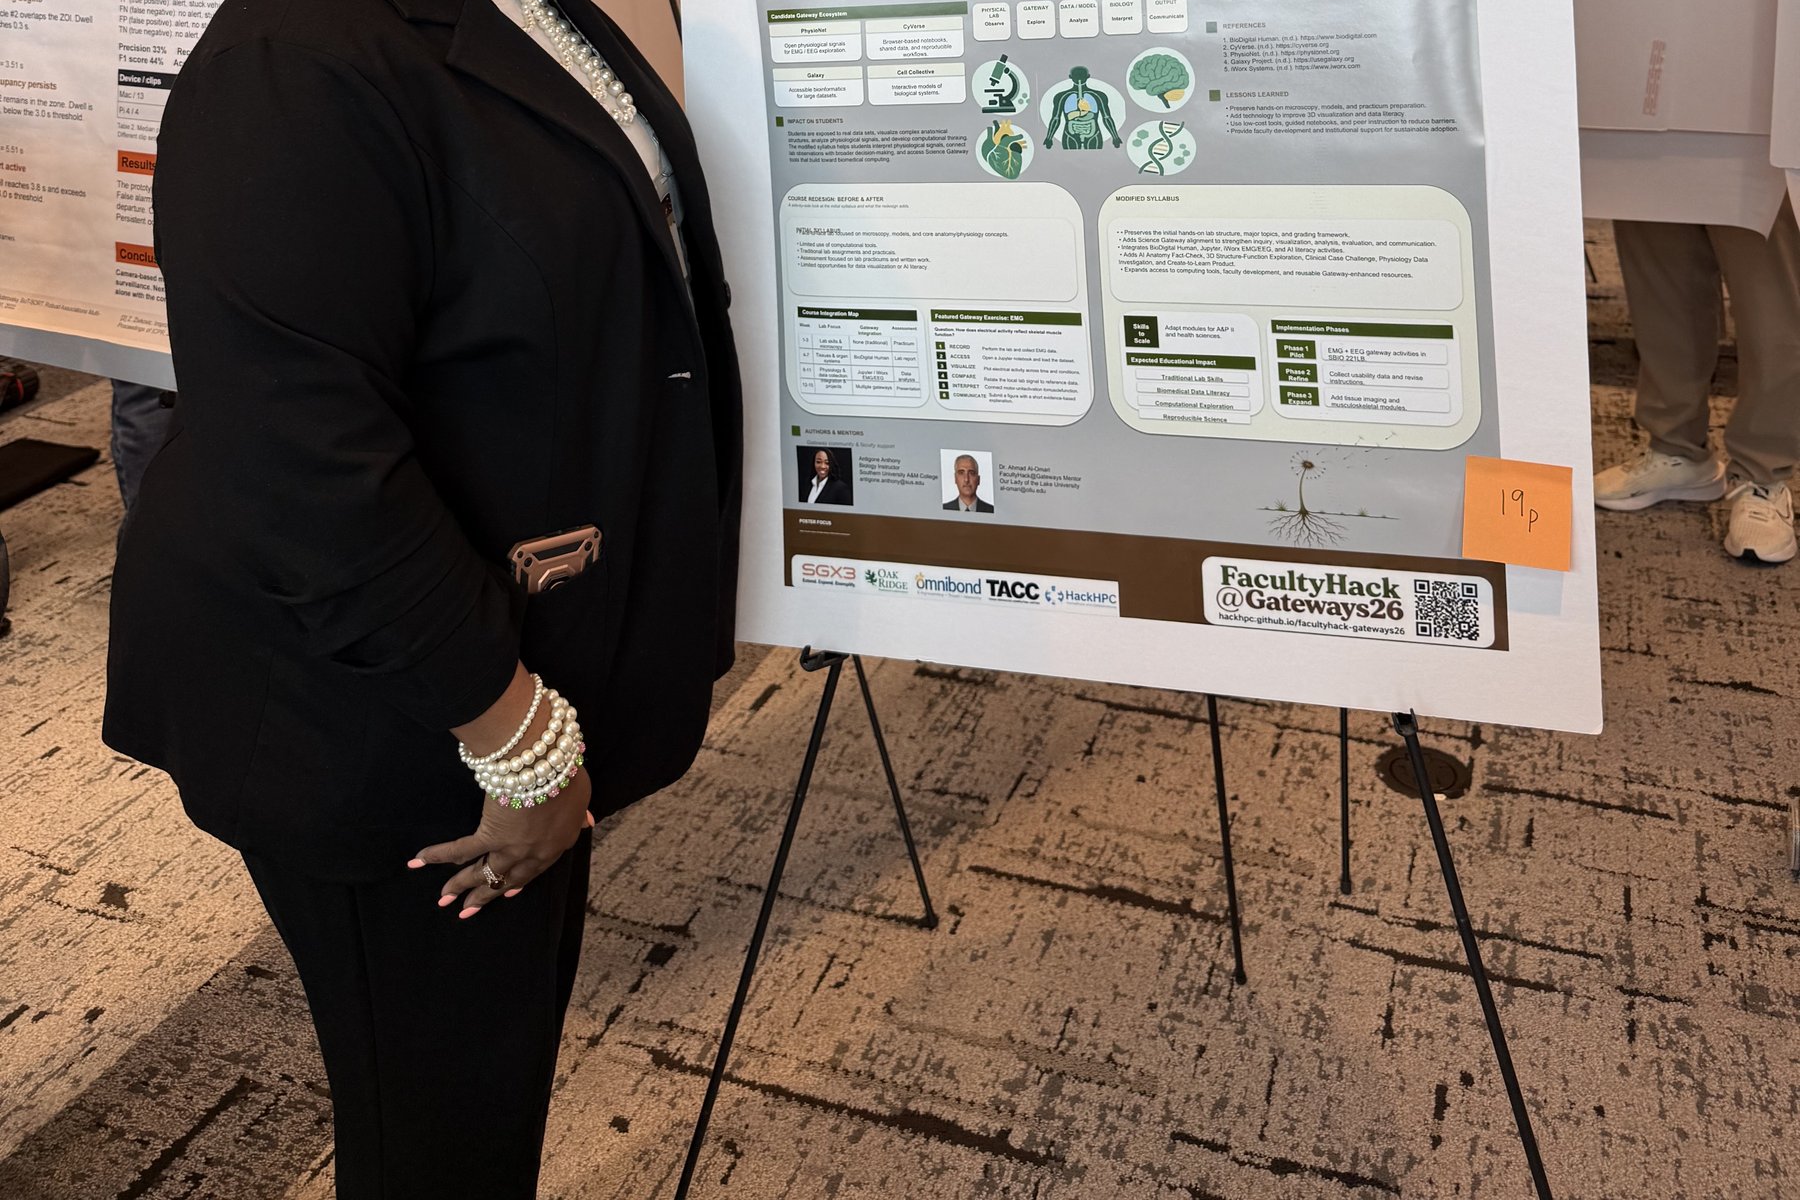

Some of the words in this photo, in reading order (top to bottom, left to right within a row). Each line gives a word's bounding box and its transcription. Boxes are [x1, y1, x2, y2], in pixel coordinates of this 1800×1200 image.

[118, 43, 150, 51] Precision
[122, 156, 156, 171] Results
[802, 563, 856, 580] SGX3
[877, 568, 899, 579] OAK
[878, 578, 908, 590] RIDGE
[916, 575, 982, 595] omnibond
[986, 579, 1040, 600] TACC
[1220, 564, 1402, 599] FacultyHack
[1065, 590, 1117, 604] HackHPC
[1216, 586, 1404, 622] @Gateways26
